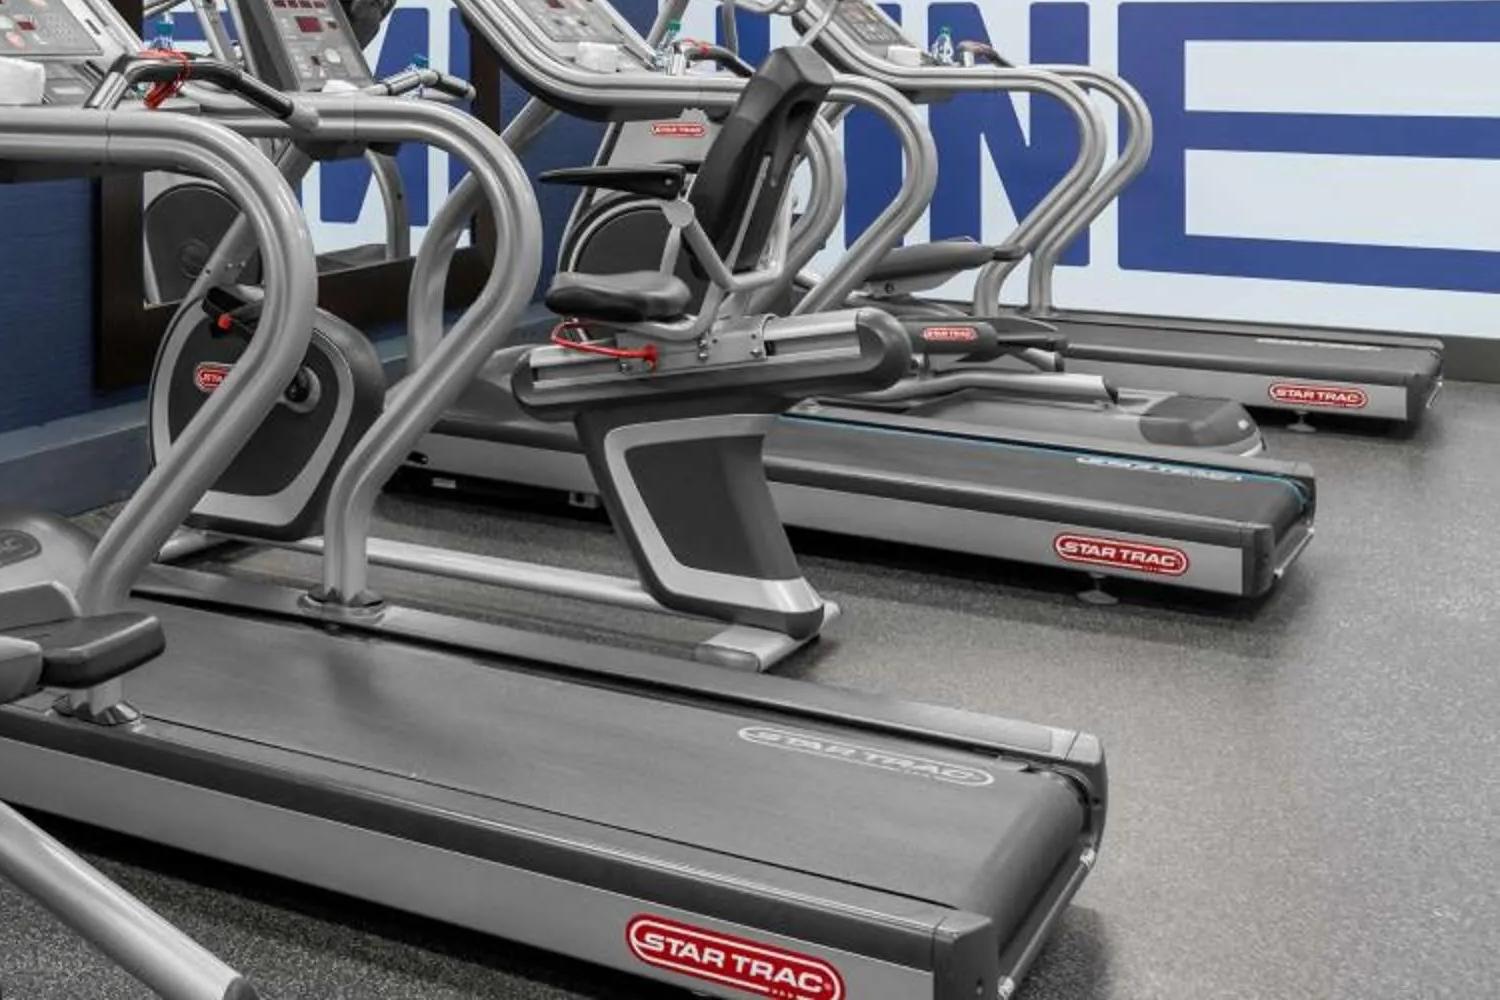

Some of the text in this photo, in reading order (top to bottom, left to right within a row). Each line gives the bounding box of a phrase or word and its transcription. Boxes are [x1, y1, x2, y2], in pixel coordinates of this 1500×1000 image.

[1275, 388, 1359, 403] STAR TRAC
[1063, 541, 1176, 567] STAR TRAC
[756, 730, 976, 781] STAR TRAC
[642, 932, 824, 994] STAR TRAC
